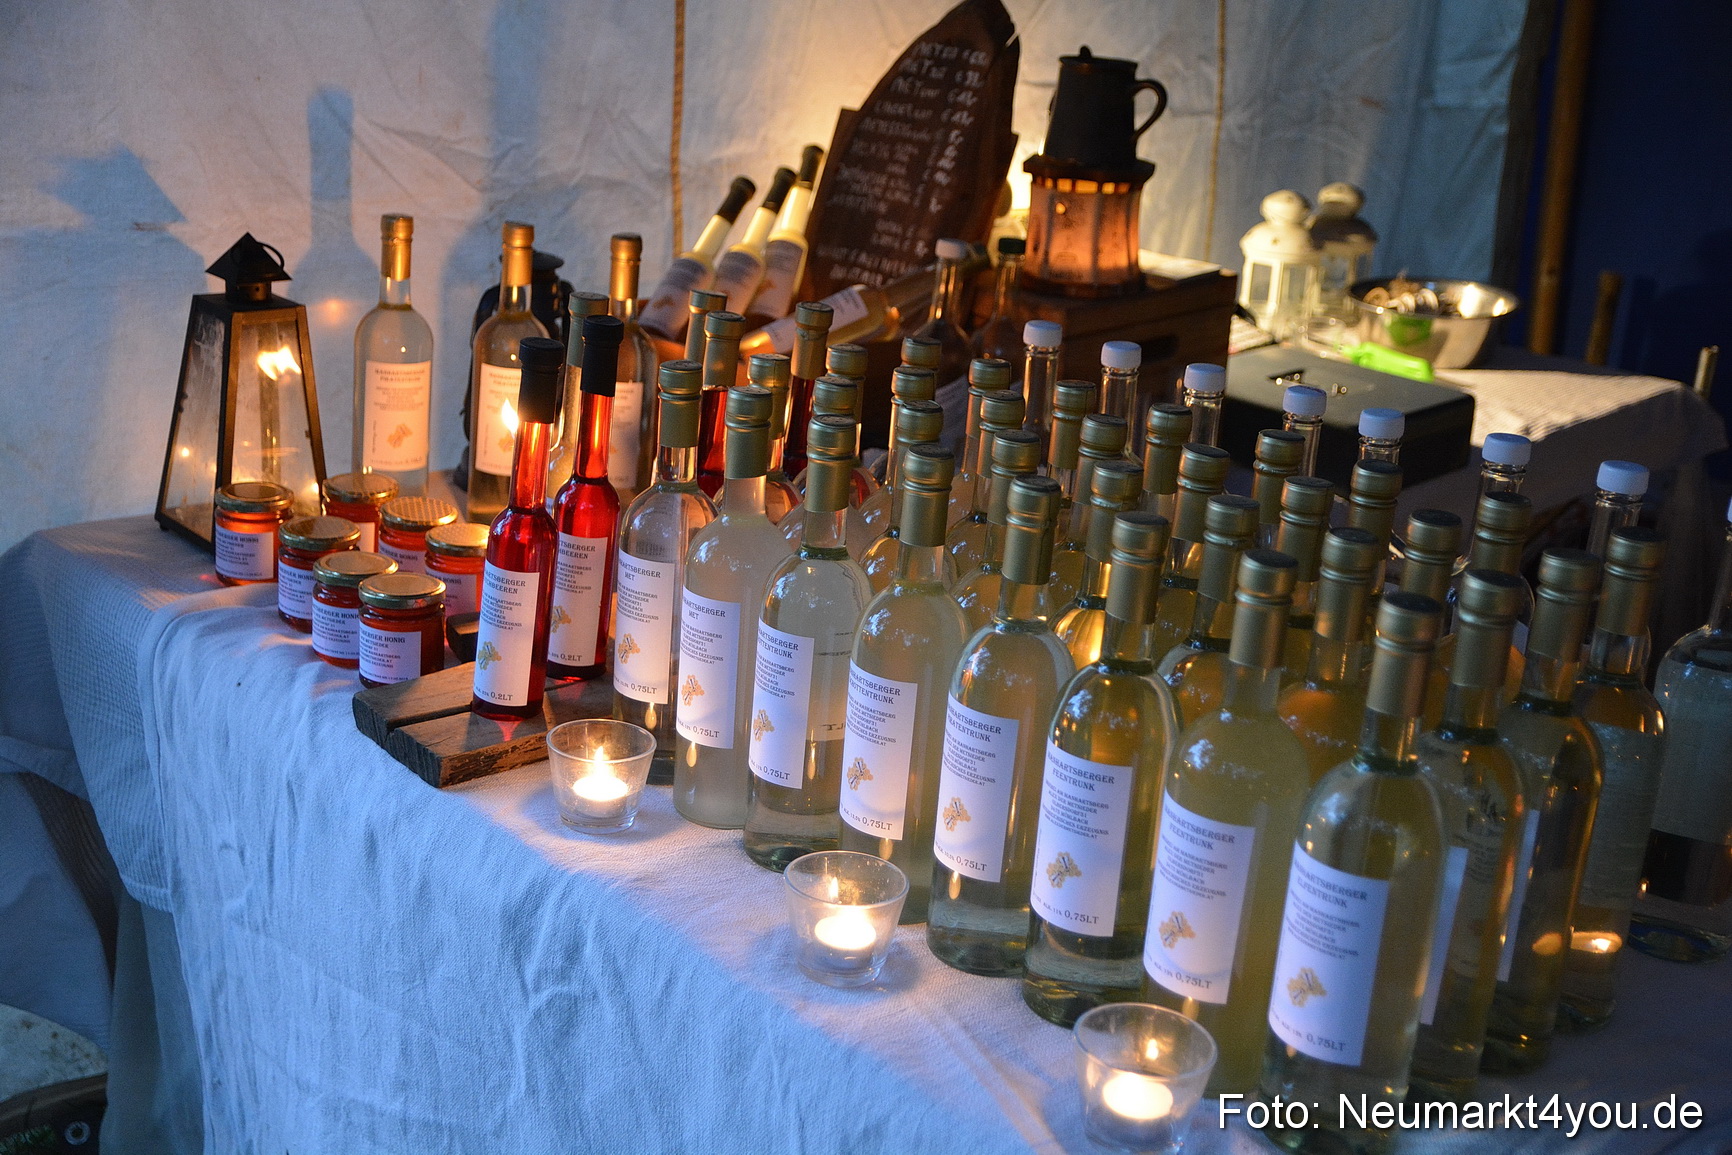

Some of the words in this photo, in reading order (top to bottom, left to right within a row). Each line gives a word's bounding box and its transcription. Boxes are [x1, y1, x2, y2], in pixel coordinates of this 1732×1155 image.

[624, 572, 635, 581] MET
[689, 610, 699, 620] MET
[631, 683, 657, 694] 0,75LT
[491, 692, 513, 701] 0,2LT
[693, 726, 719, 738] 0,75LT
[763, 766, 790, 780] 0,75LT
[1053, 768, 1095, 791] FEENTRUNK
[1064, 792, 1109, 809] MANHARTSBERG
[1067, 800, 1097, 814] METSIEDER
[862, 817, 892, 830] 0,75LT
[1076, 823, 1109, 835] ERZEUGNIS
[1169, 823, 1214, 850] FEENTRUNK
[956, 856, 987, 871] 0,75LT
[1297, 876, 1347, 909] ELFENTRUNK
[1065, 910, 1099, 924] 0,75LT
[1175, 972, 1213, 989] 0,75LT
[1307, 1033, 1346, 1052] 0,75LT
